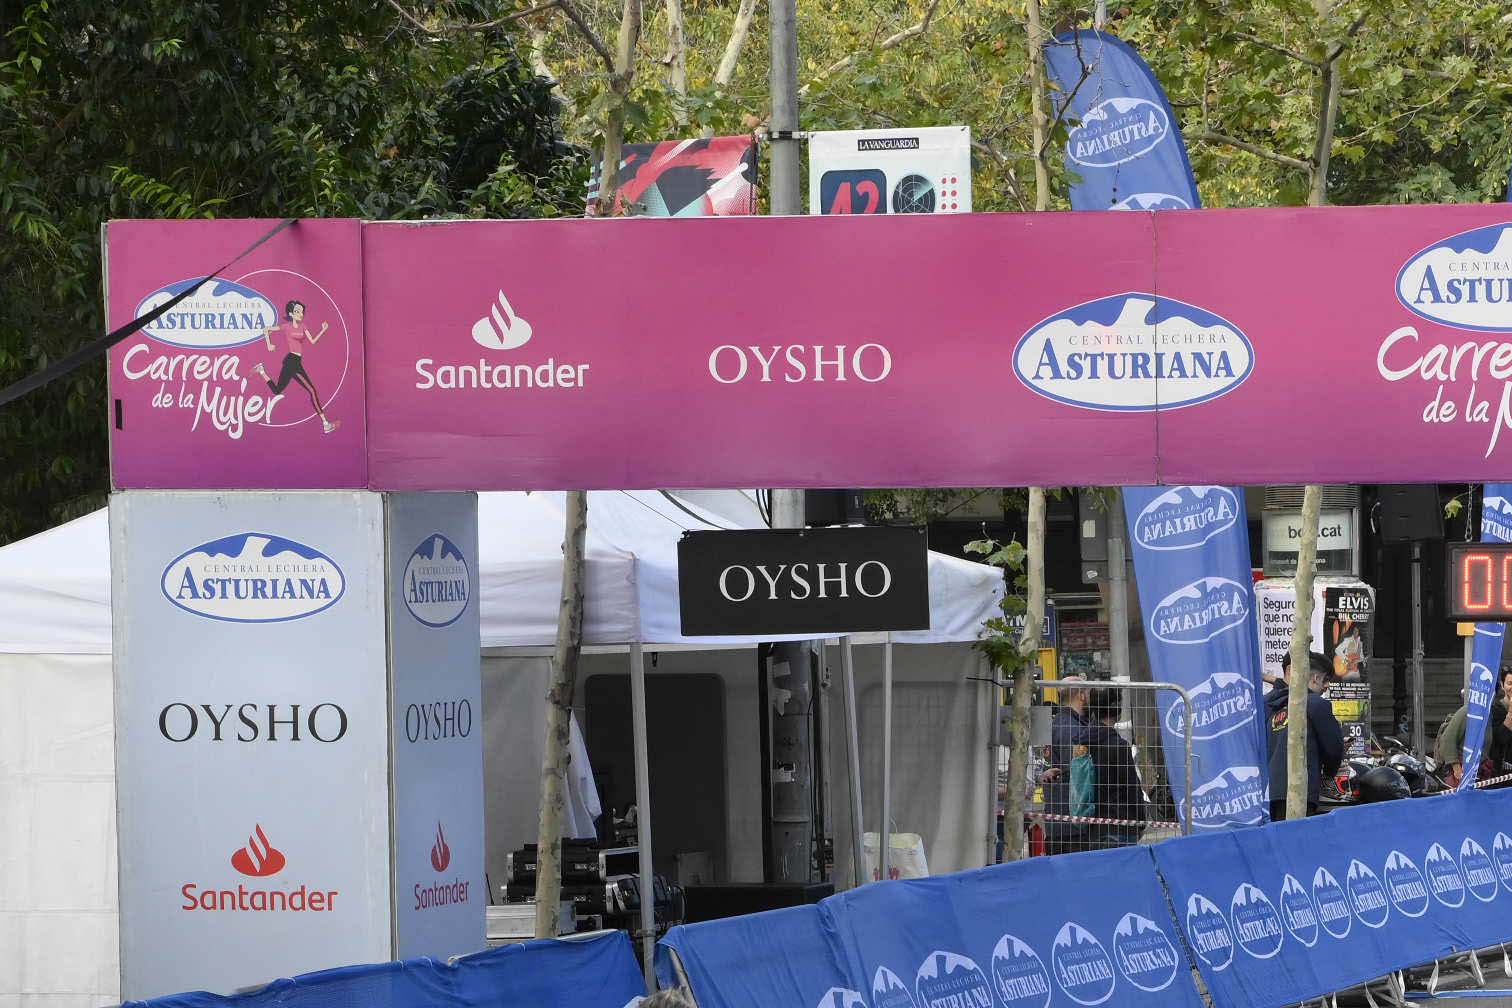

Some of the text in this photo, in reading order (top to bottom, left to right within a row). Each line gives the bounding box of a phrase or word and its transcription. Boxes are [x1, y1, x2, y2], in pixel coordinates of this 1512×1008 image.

[868, 138, 918, 149] VANGUARDIA
[174, 301, 215, 310] ENTRAL
[1069, 333, 1227, 346] CENTRAL LECHERA
[123, 344, 241, 380] Carrera
[416, 358, 590, 389] Santander
[709, 343, 891, 384] OYSHO
[1032, 337, 1235, 381] ASTURIANA
[152, 378, 285, 439] de la Mujer
[1423, 384, 1457, 423] de
[1465, 383, 1490, 423] la
[176, 566, 332, 600] ASTURIANA
[204, 564, 325, 574] CENTRAL LECHERA
[719, 560, 892, 601] OYSHO
[408, 570, 466, 605] ASTURIANA
[1339, 597, 1368, 609] ELVIS
[1264, 613, 1280, 625] que
[1264, 626, 1295, 637] quiere
[158, 703, 348, 743] OYSHO
[406, 698, 472, 744] OYSHO
[182, 884, 338, 911] Santander
[414, 879, 469, 911] Santander
[1058, 956, 1112, 988] ASTURIANA
